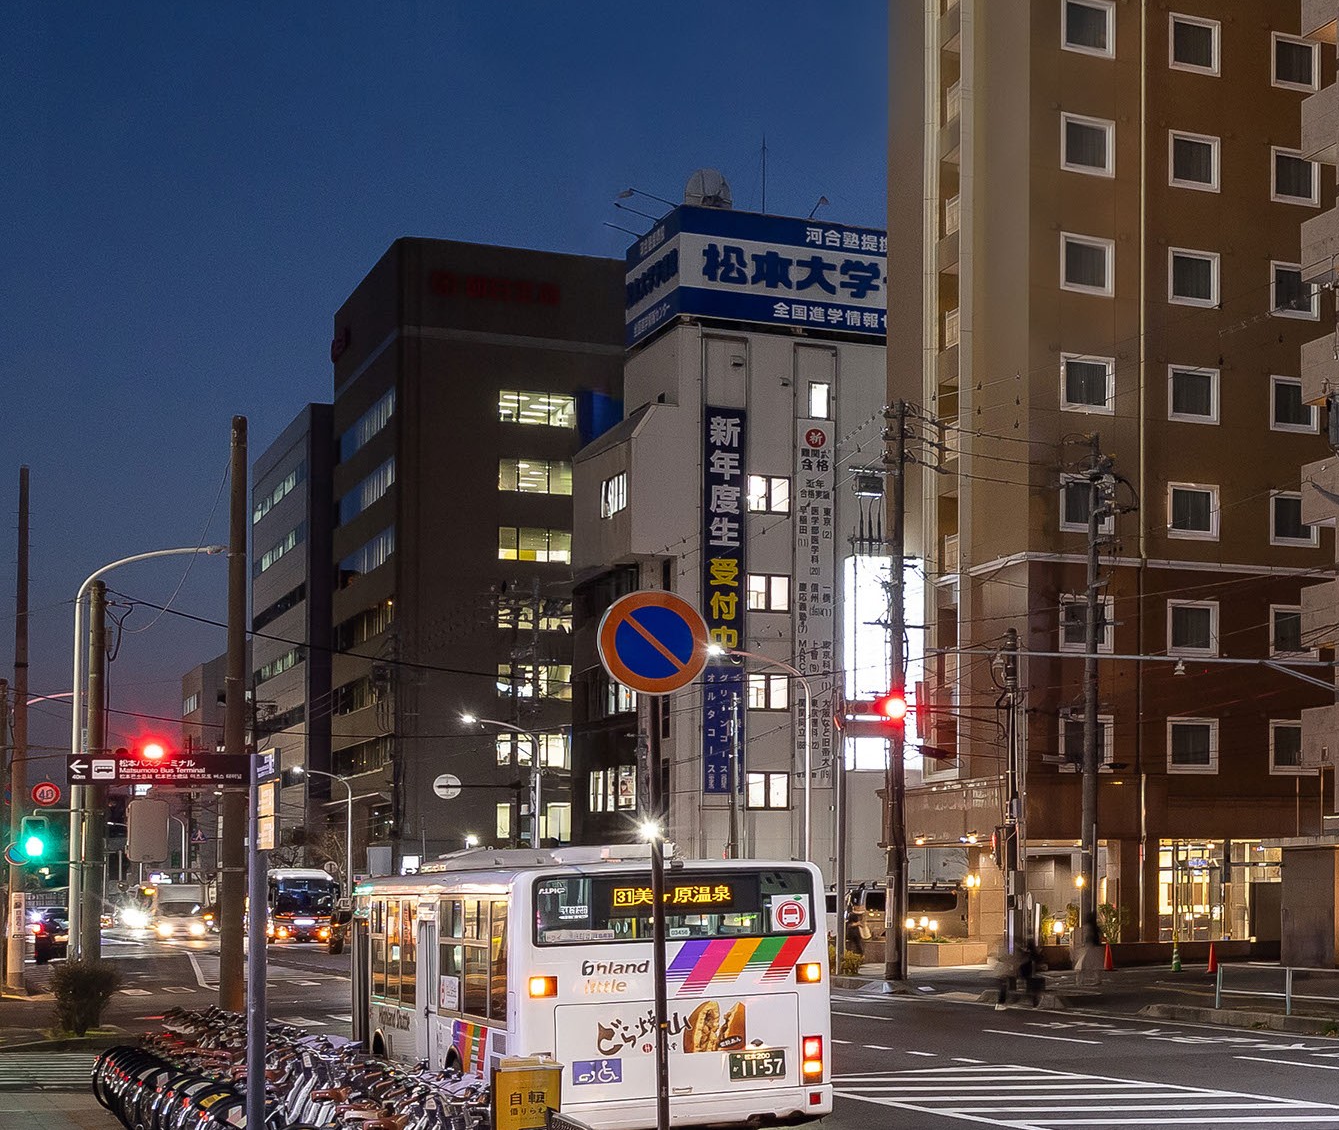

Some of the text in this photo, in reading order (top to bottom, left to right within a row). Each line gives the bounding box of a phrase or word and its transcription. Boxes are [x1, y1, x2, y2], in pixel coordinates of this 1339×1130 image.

[702, 243, 887, 300] 松本大学
[801, 459, 829, 471] 合格
[119, 759, 196, 768] 松本バスターミナル
[616, 889, 632, 904] 31
[741, 1058, 783, 1077] 11-57
